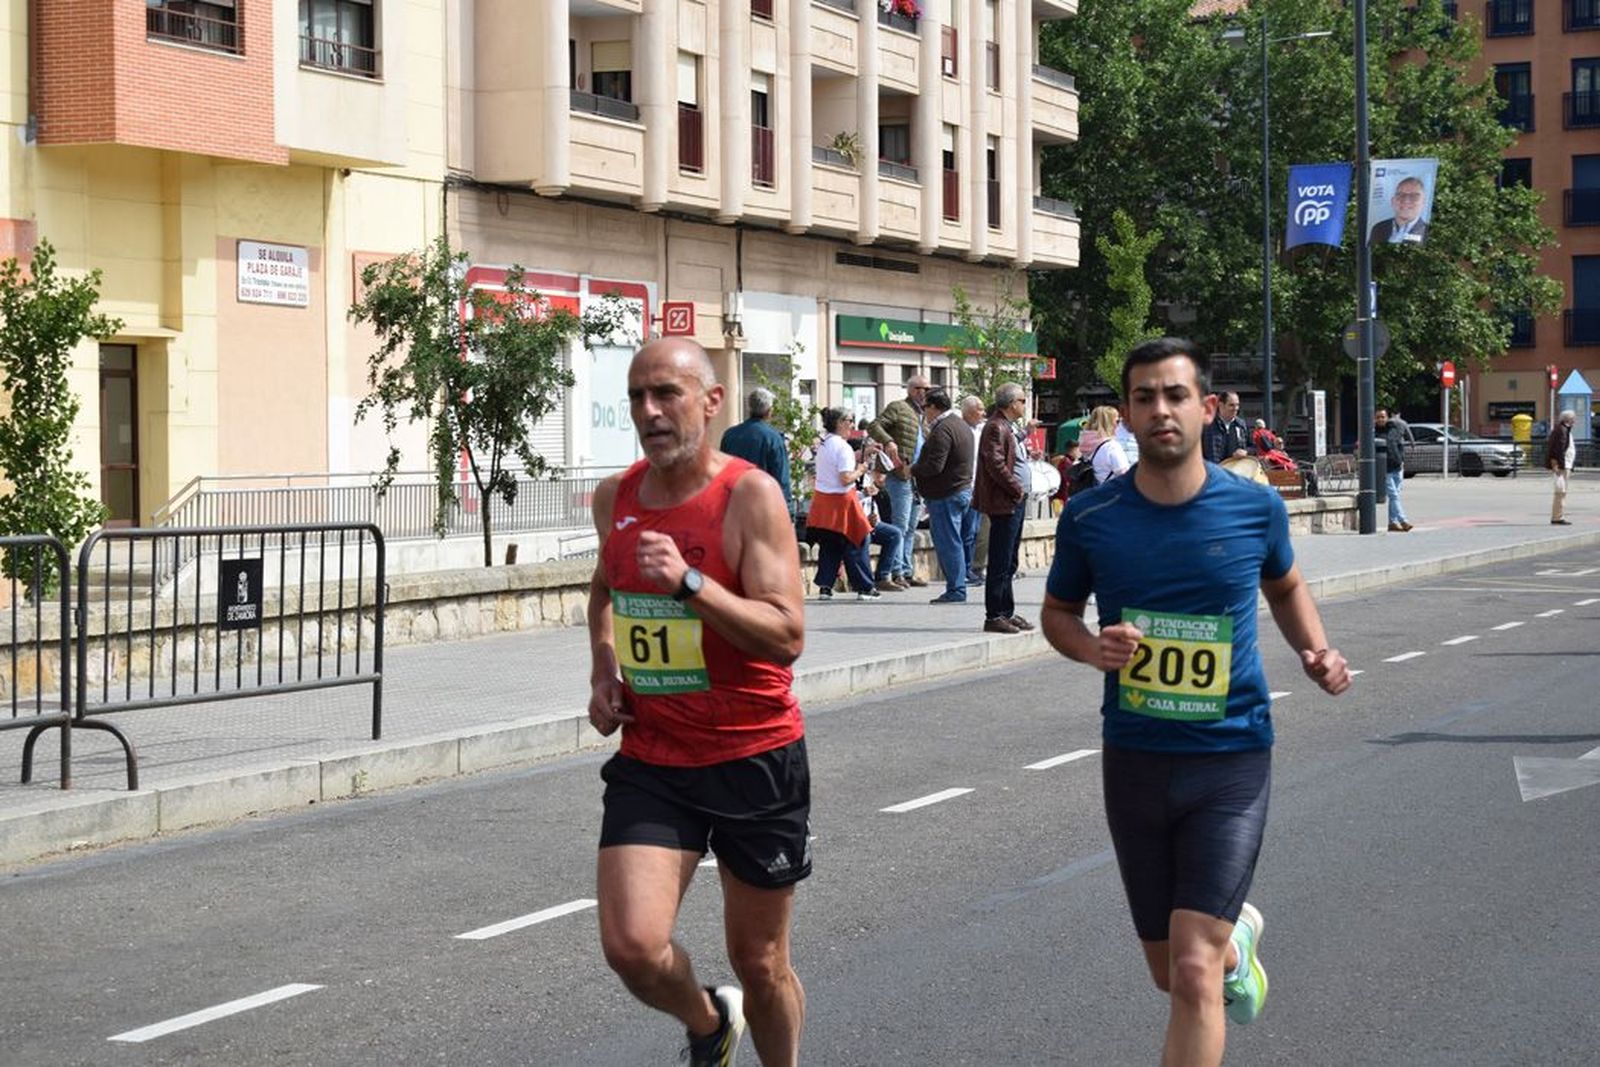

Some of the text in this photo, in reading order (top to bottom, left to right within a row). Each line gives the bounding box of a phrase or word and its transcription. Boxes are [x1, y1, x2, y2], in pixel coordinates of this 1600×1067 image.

[1298, 184, 1335, 198] VOTA
[247, 262, 268, 275] PLAZA
[1153, 627, 1217, 640] CAJA RURAL
[630, 625, 670, 664] 61
[1129, 643, 1216, 689] 209
[634, 675, 702, 686] CAJA RURAL
[1147, 697, 1219, 713] CAJA RURAL
